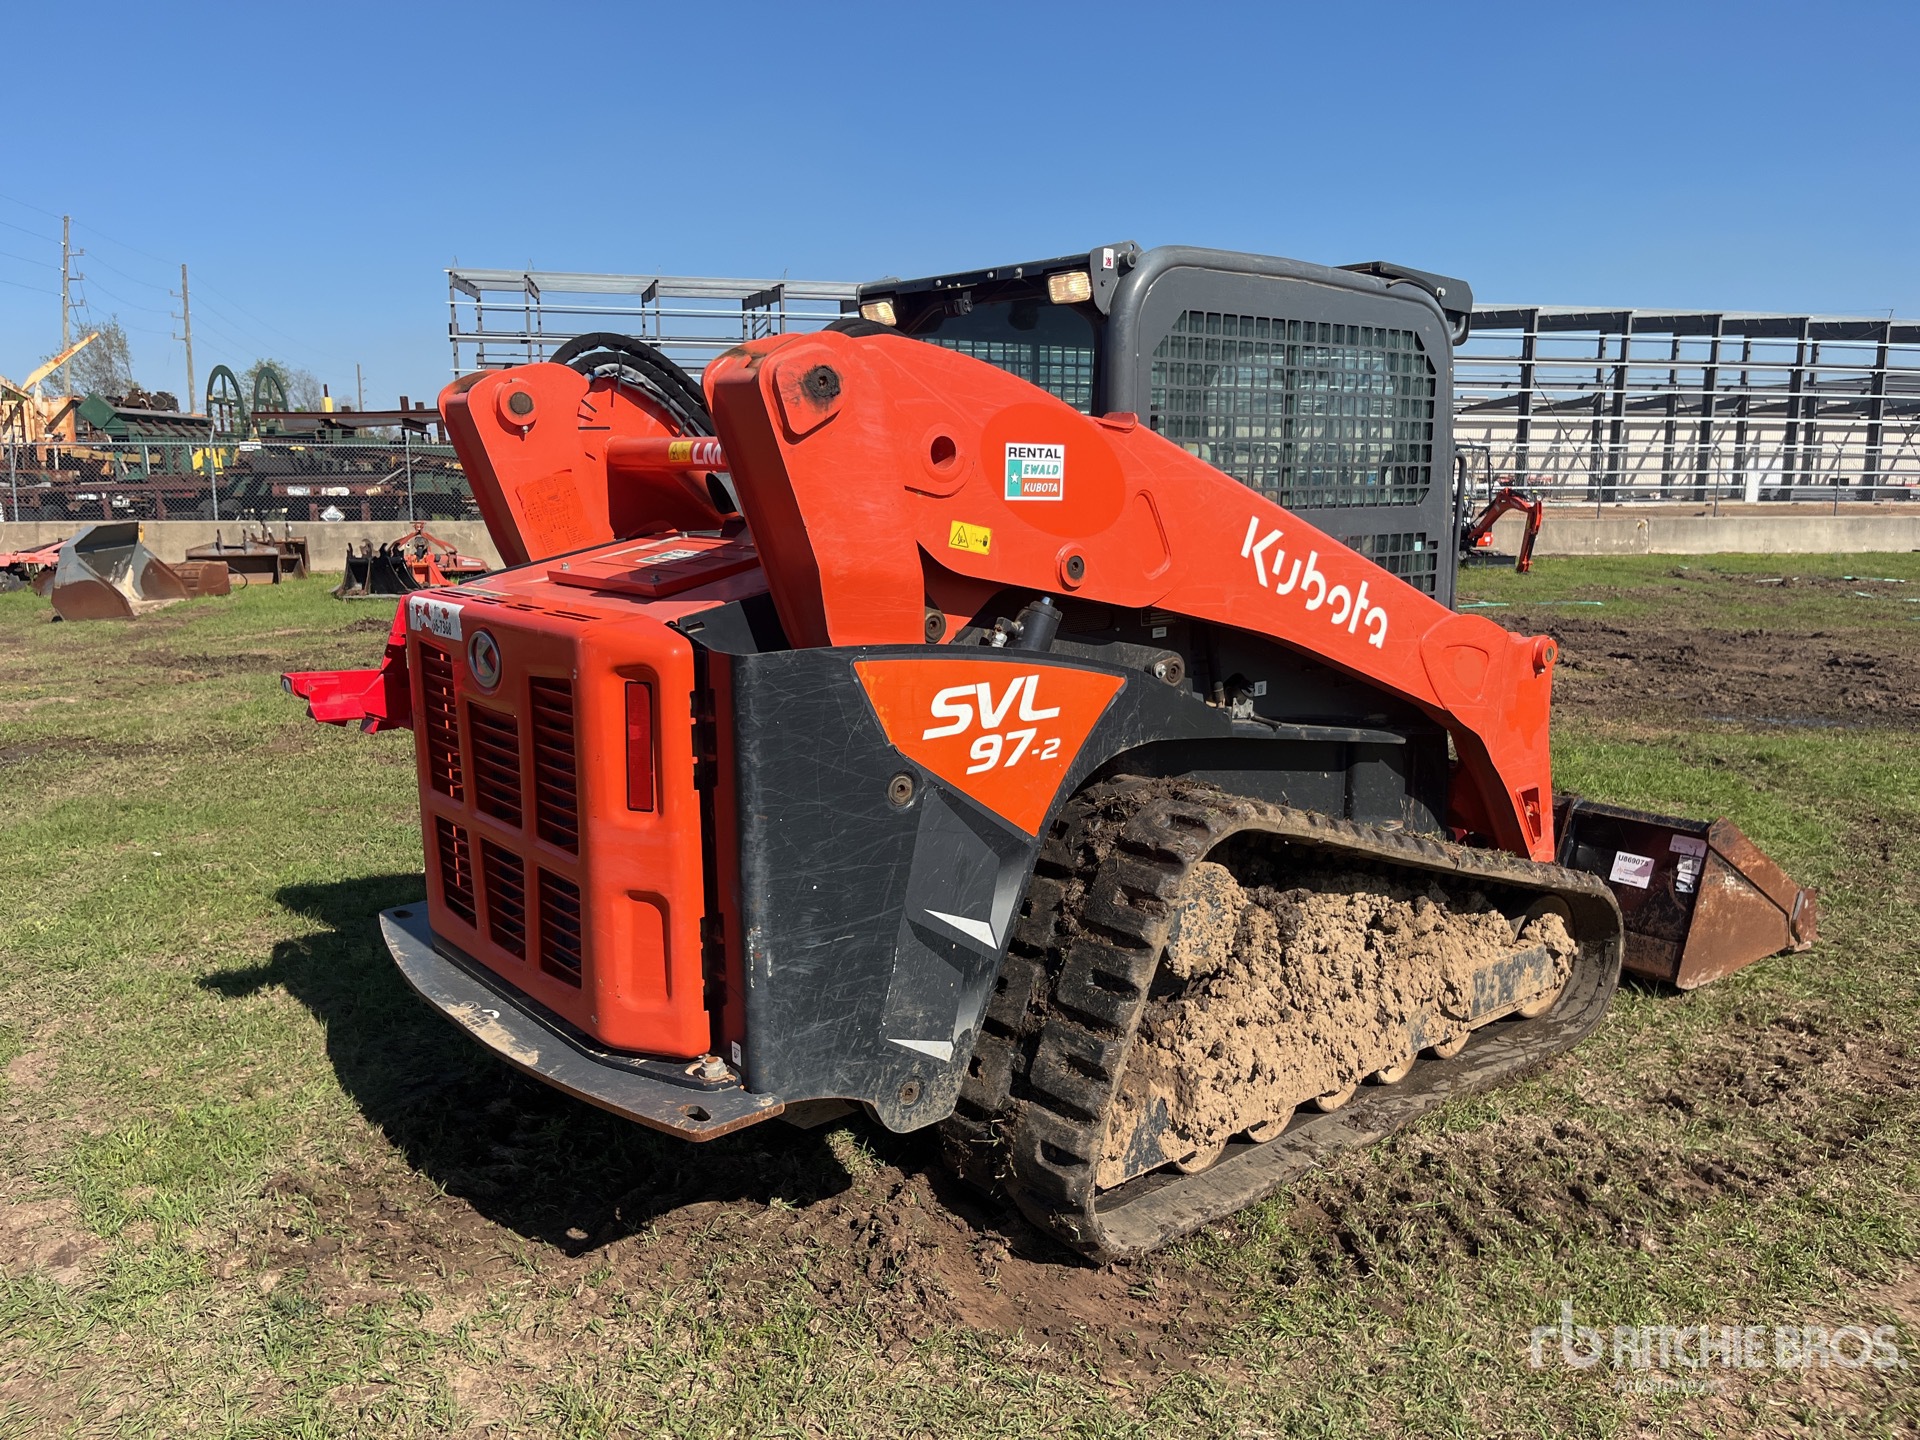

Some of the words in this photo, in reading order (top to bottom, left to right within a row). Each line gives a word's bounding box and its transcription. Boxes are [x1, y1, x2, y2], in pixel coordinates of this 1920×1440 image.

[1008, 446, 1061, 459] RENTAL
[1023, 464, 1059, 475] EWALD
[1023, 482, 1058, 493] KUBOTA
[1240, 515, 1388, 649] Kubota
[922, 674, 1061, 741] SVL
[966, 727, 1061, 775] 97-2
